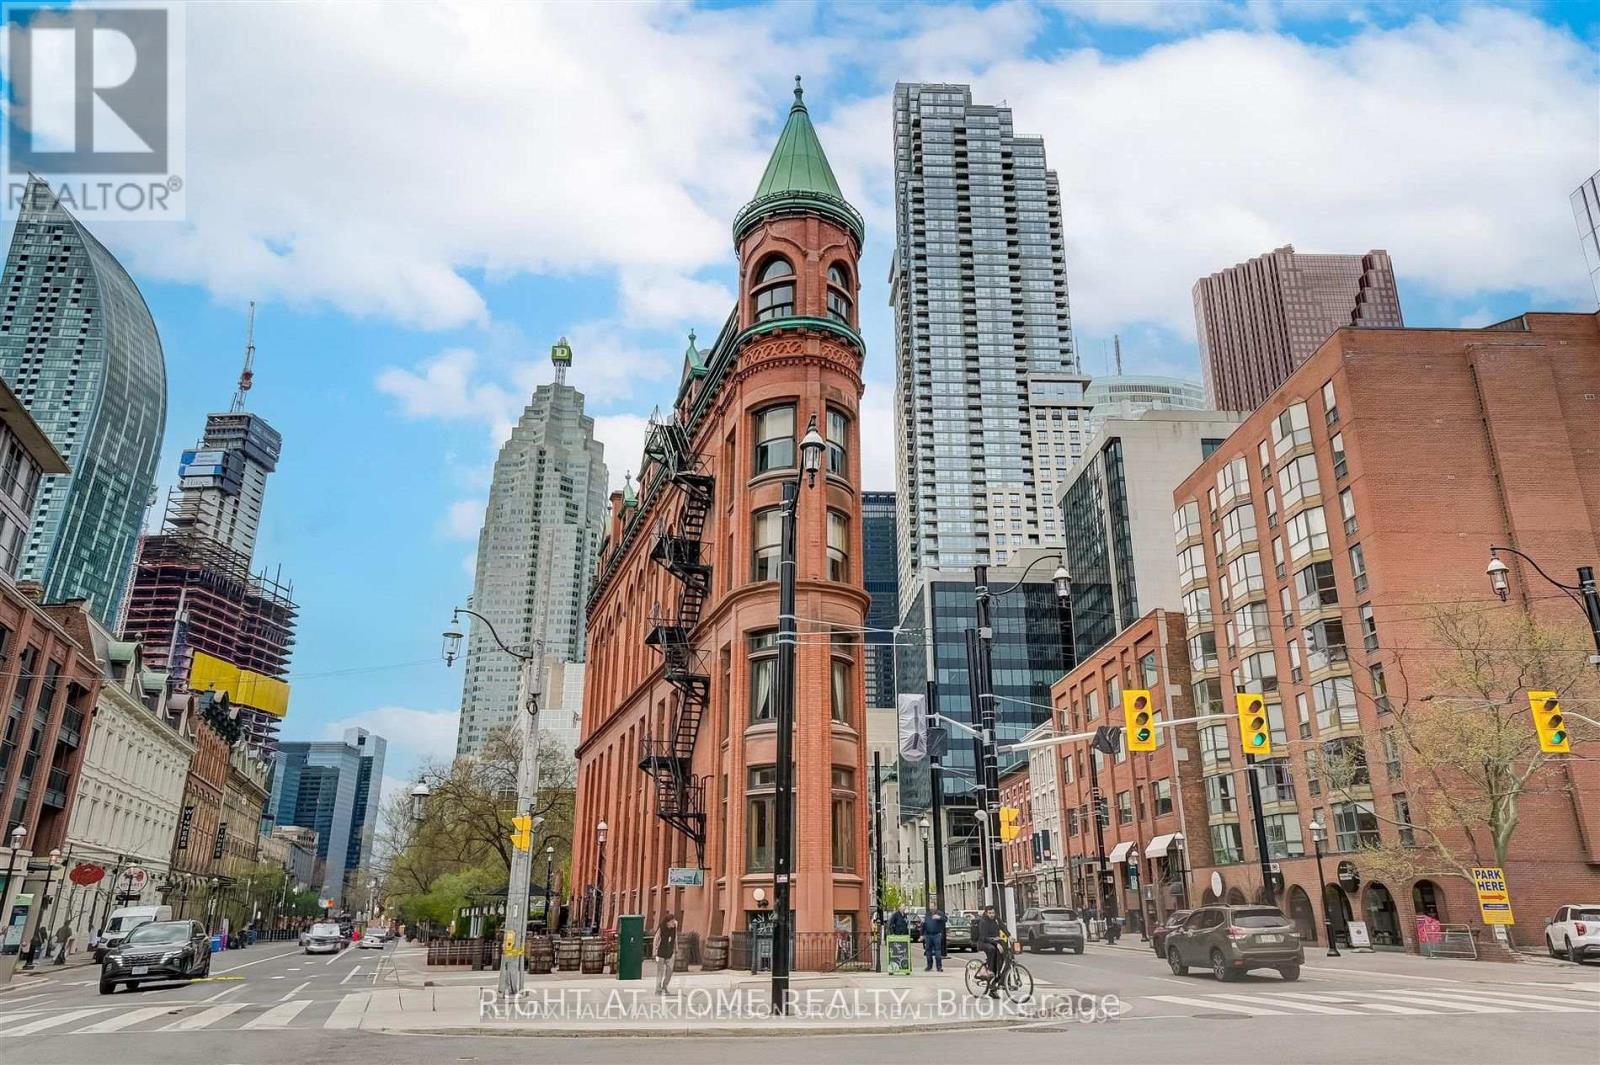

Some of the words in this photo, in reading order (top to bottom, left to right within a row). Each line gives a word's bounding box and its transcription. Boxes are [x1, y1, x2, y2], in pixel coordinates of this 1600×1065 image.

[554, 347, 568, 357] TD
[179, 809, 194, 847] WINNERS
[1474, 870, 1502, 880] PARK
[1477, 881, 1505, 891] HERE
